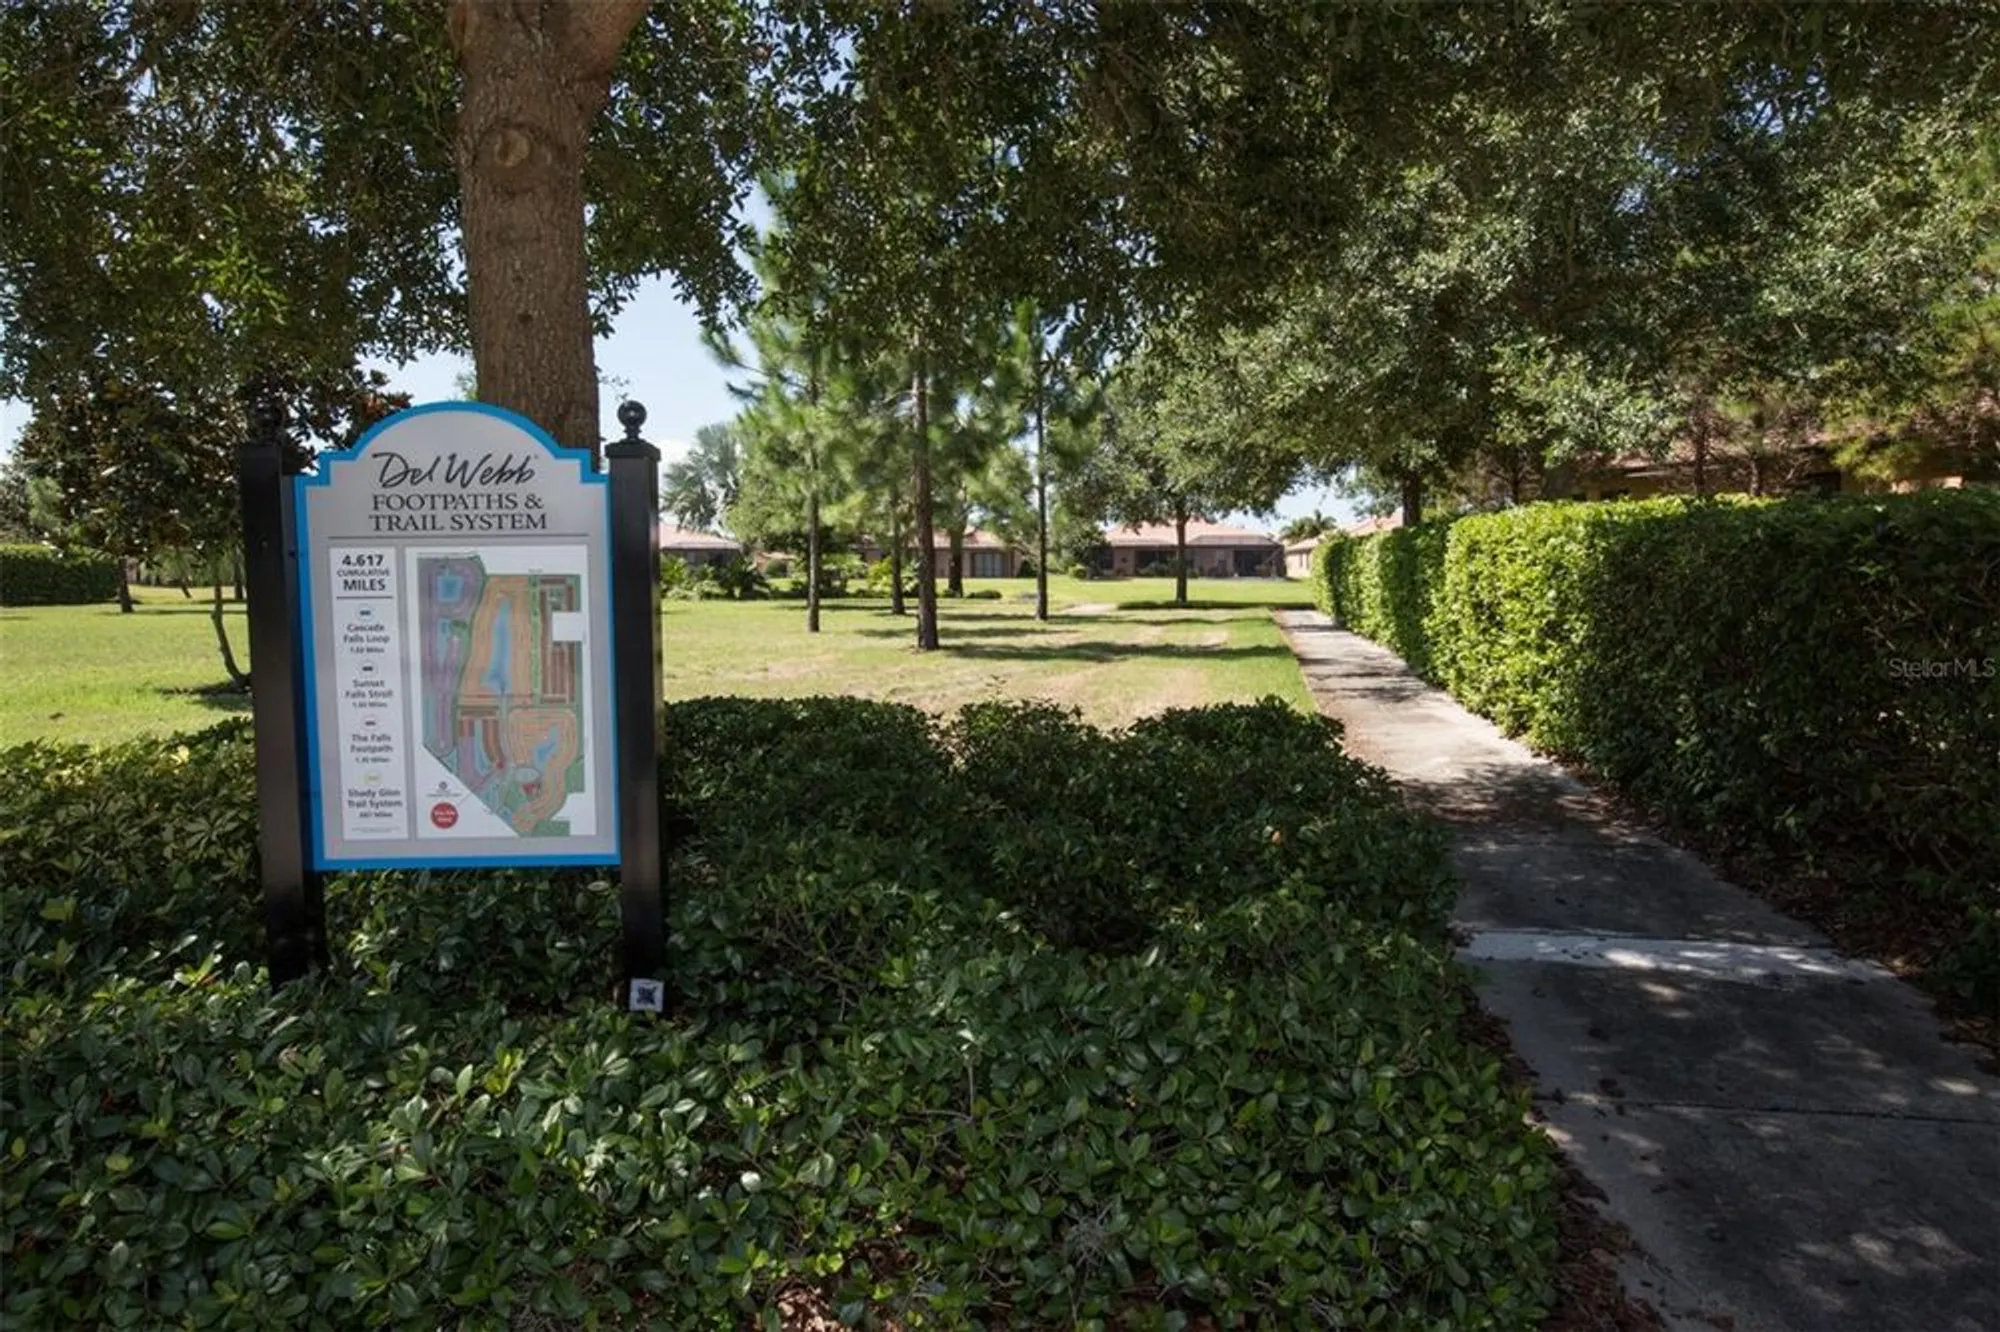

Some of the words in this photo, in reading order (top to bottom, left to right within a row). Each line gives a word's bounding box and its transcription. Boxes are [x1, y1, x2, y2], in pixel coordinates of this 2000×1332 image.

[372, 452, 441, 489] Del
[446, 452, 536, 489] Webb
[372, 493, 518, 511] FOOTPATHS
[524, 493, 545, 510] &
[369, 514, 444, 532] TRAIL
[450, 513, 547, 531] SYSTEM
[342, 554, 384, 567] 4.617
[343, 578, 386, 591] MILES
[346, 623, 385, 632] Cascade
[343, 634, 365, 643] Falls
[366, 634, 391, 643] Loop
